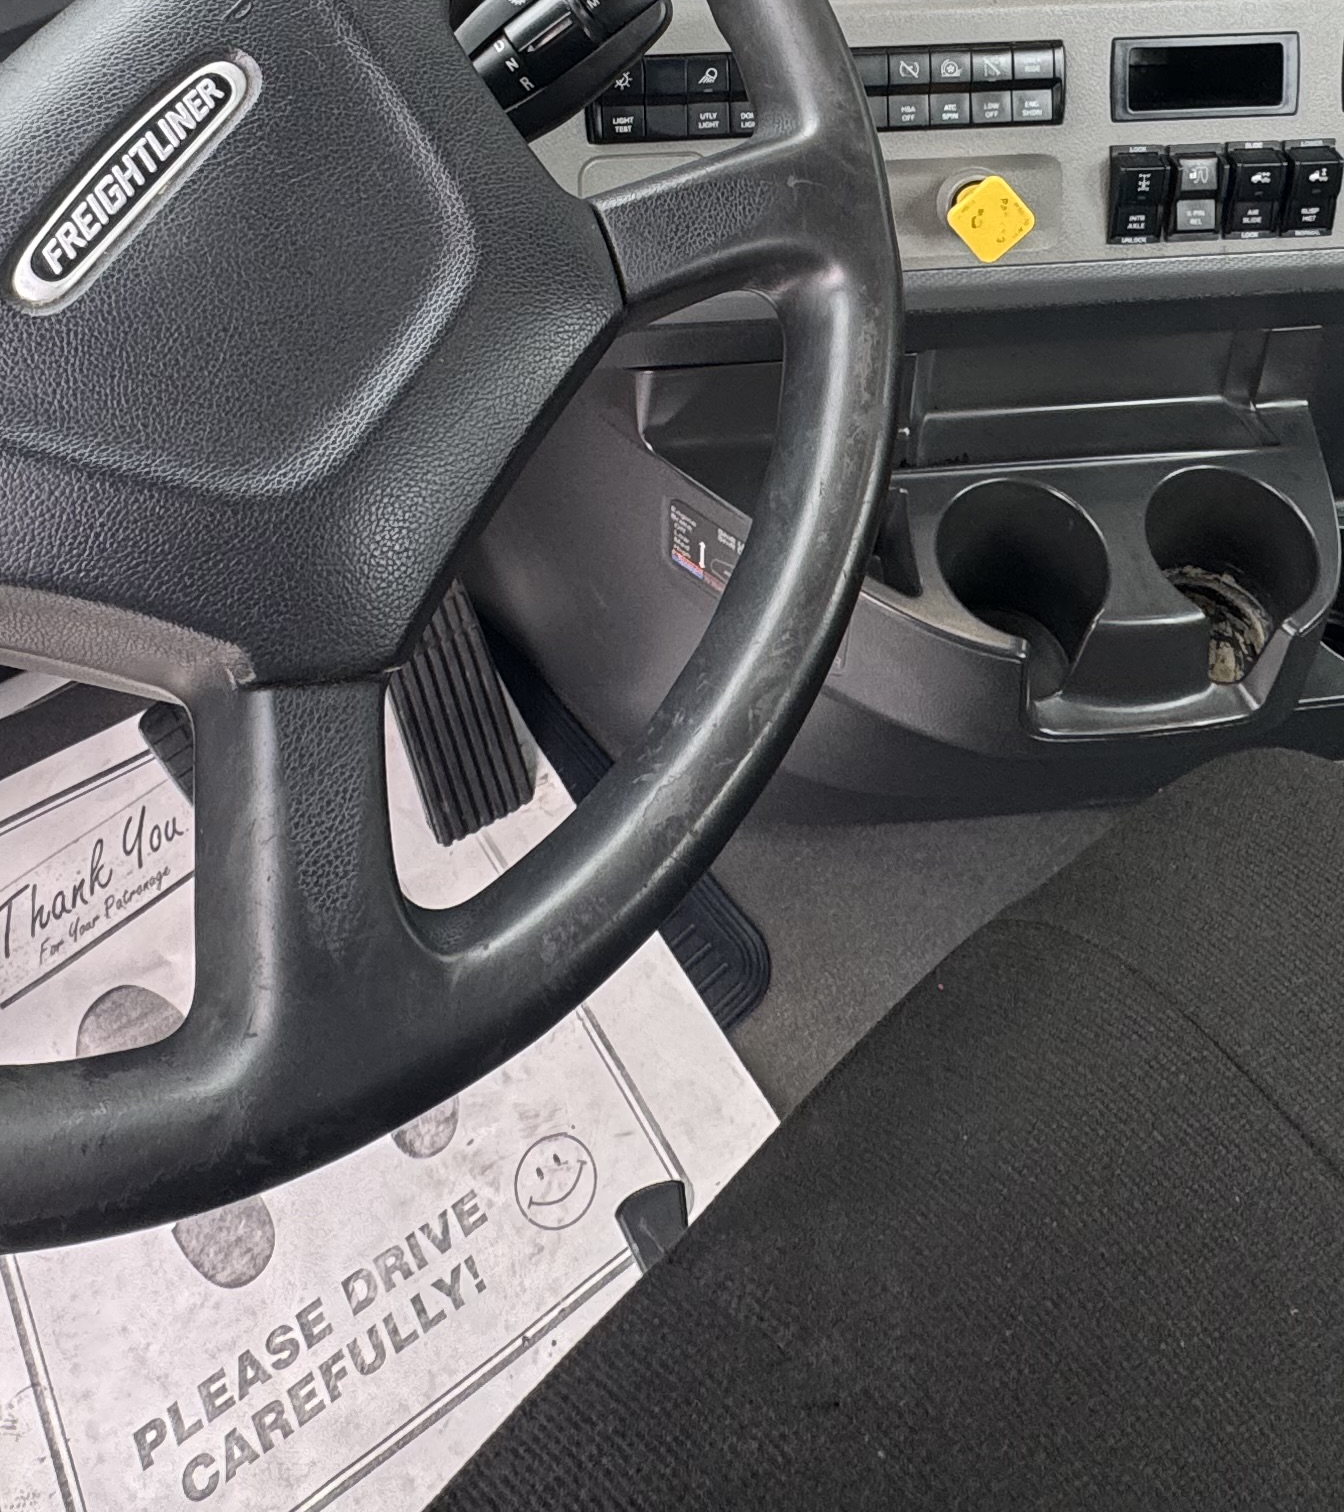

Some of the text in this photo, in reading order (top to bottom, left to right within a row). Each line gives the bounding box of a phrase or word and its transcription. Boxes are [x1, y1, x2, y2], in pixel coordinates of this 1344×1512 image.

[493, 40, 505, 53] D
[505, 57, 519, 72] N
[520, 76, 535, 91] R
[612, 116, 634, 125] LIGHT
[901, 114, 916, 122] OFF
[985, 110, 999, 118] OFF
[698, 120, 719, 129] LIGHT
[42, 78, 225, 275] FREIGHTLINER
[39, 866, 171, 966] For Your Patronage
[132, 1189, 489, 1471] PLEASE DRIVE
[181, 1254, 487, 1502] CAREFULLY!
